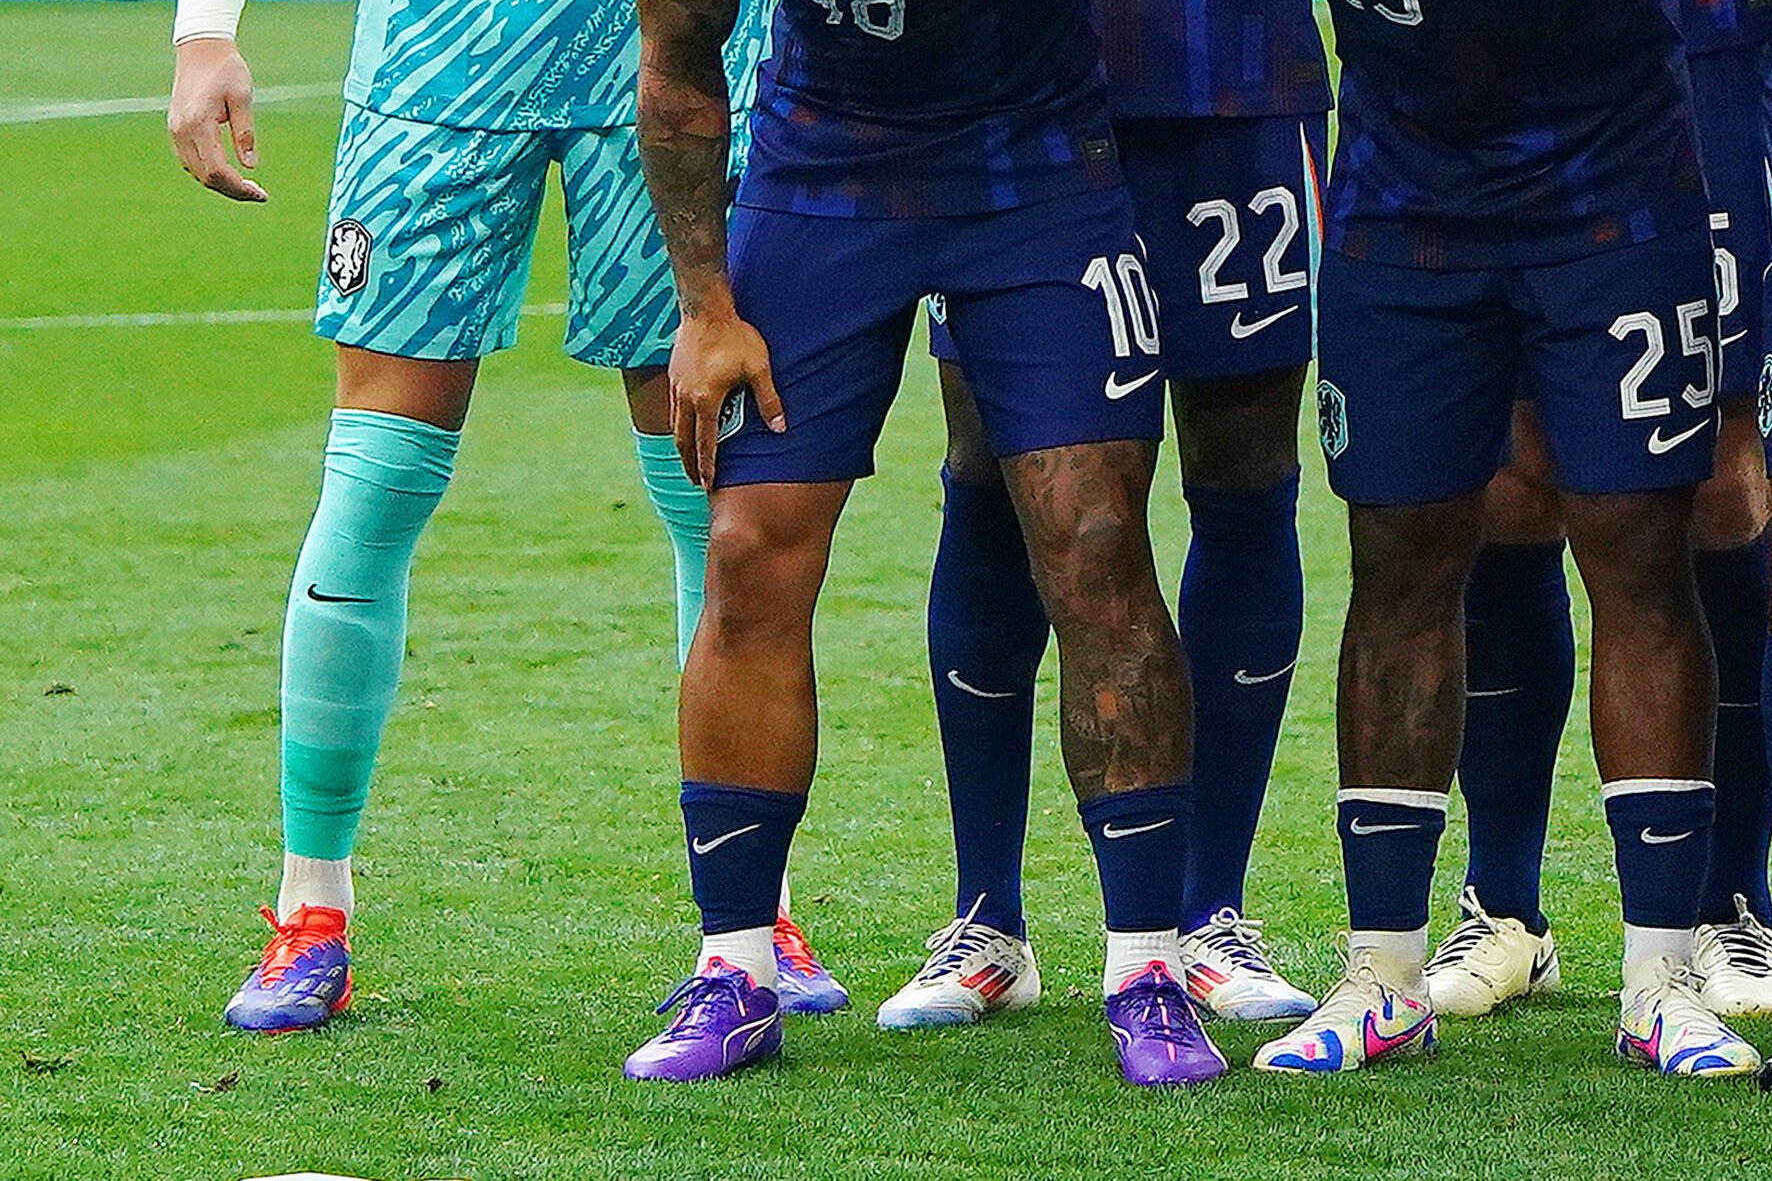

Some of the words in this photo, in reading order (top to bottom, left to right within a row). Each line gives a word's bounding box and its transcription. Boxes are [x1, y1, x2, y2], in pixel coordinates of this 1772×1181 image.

[1185, 185, 1308, 304] 22
[1080, 253, 1161, 358] 10
[1607, 299, 1715, 420] 25
